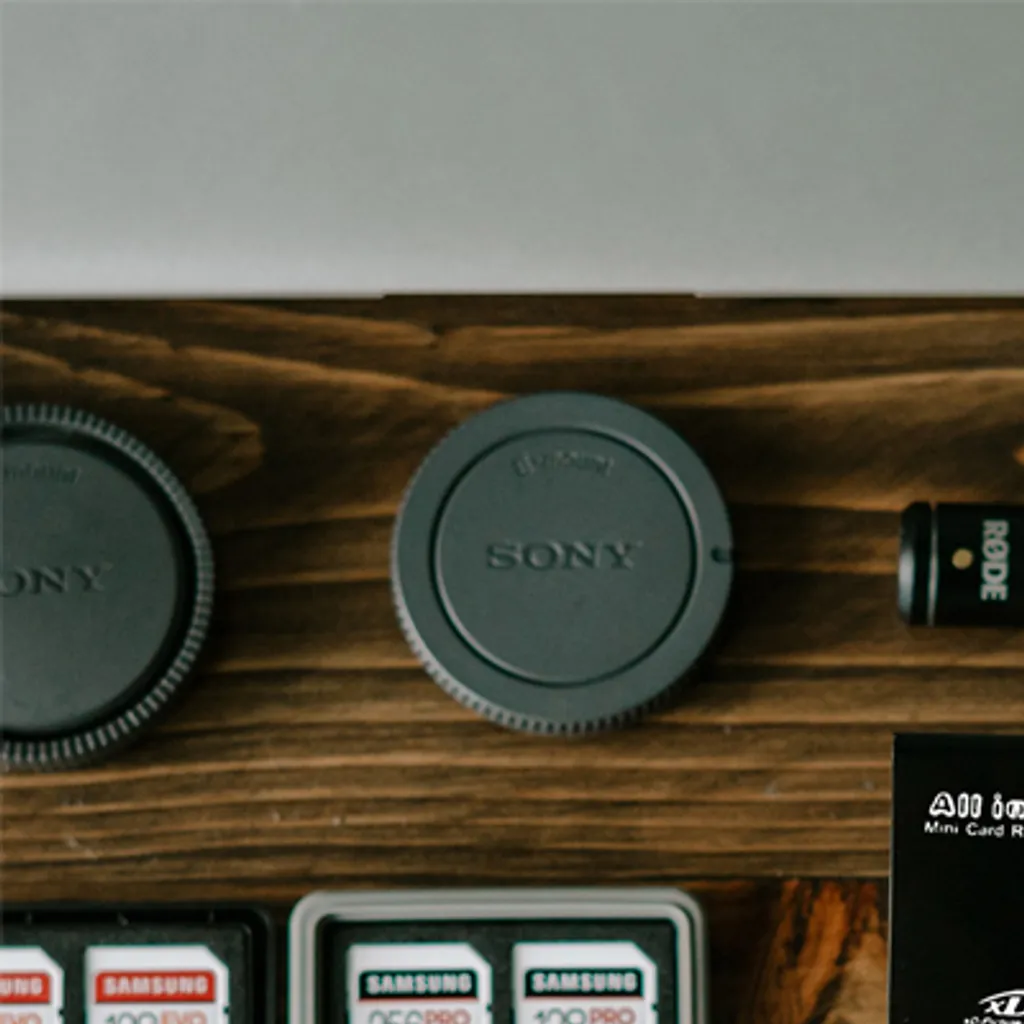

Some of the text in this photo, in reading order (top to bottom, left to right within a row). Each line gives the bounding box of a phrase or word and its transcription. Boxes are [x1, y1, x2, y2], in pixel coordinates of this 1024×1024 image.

[485, 537, 645, 573] SONY
[0, 566, 113, 599] ONY
[928, 790, 983, 820] All
[923, 820, 960, 835] Mini
[964, 821, 1006, 839] Card
[102, 975, 209, 997] SAMSUNG
[366, 973, 473, 995] SAMSUNG
[531, 971, 639, 993] SAMSUNG
